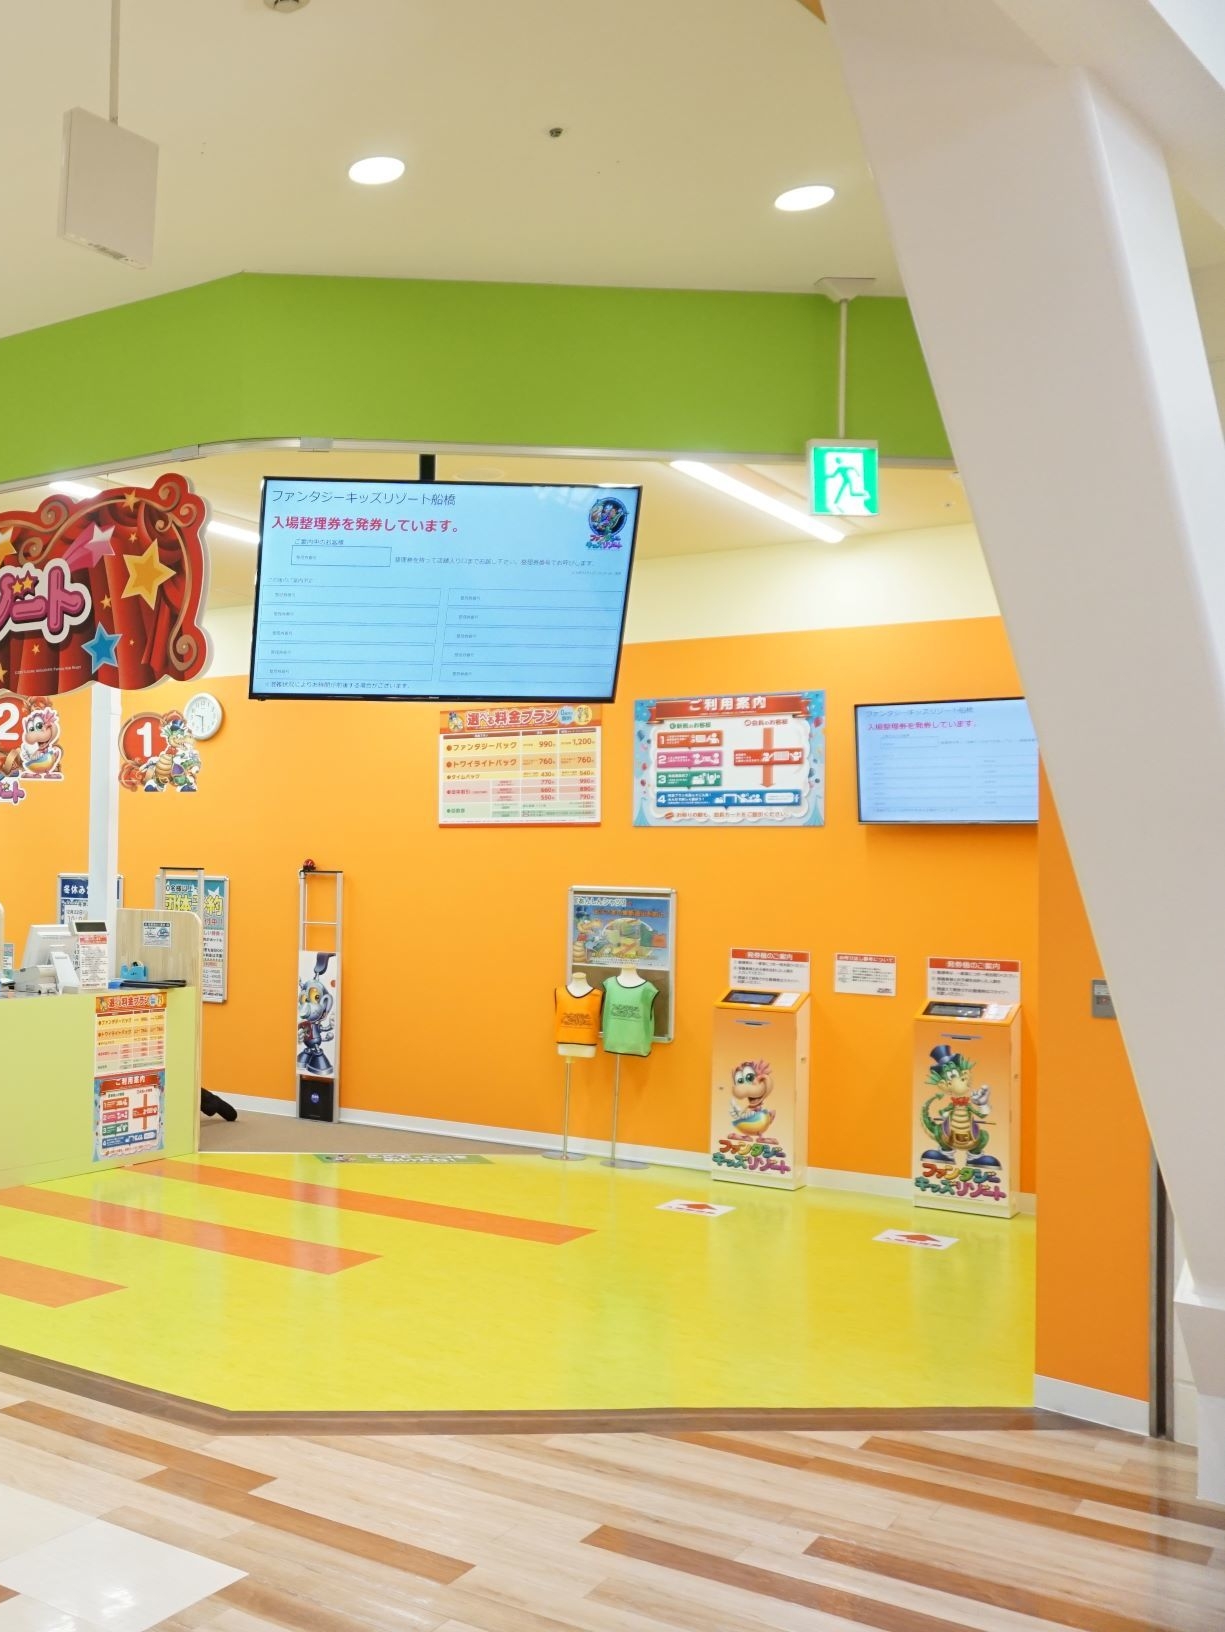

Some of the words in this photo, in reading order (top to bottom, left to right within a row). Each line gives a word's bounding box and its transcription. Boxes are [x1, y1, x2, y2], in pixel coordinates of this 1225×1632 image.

[272, 489, 456, 506] ファンタジーキッズリゾート船橋
[271, 515, 459, 533] 入場整理券を発券しています。
[688, 697, 767, 711] ご利用案内
[466, 709, 557, 727] 選べる料金プラン
[136, 727, 153, 757] 1
[453, 742, 517, 751] ファンタジーパック
[453, 758, 517, 768] トワイライトパック
[658, 755, 666, 764] 2
[658, 774, 666, 784] 3
[657, 794, 666, 804] 4
[63, 884, 88, 895] 冬休み
[116, 1075, 146, 1086] ご利用案内
[718, 1139, 787, 1158] ファンタジー
[712, 1151, 791, 1174] キッズリゾート
[921, 1162, 1001, 1183] ファンタジー
[914, 1176, 1007, 1201] キッズリゾート
